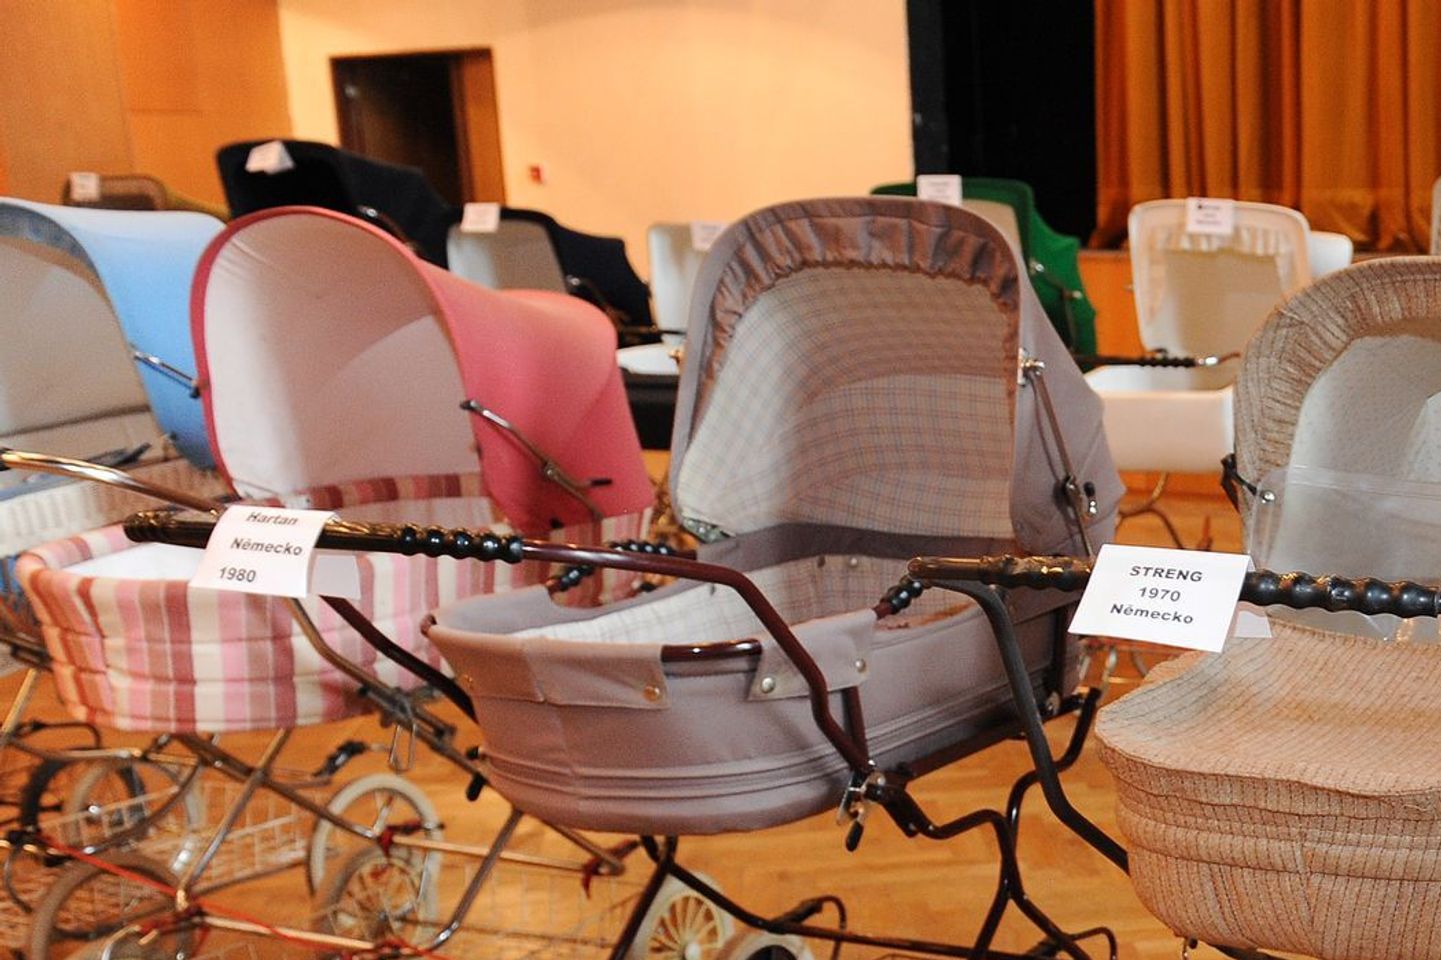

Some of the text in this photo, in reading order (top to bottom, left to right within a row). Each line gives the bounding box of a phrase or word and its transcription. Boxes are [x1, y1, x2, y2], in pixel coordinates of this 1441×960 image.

[246, 511, 299, 526] Hartan
[230, 537, 303, 556] Německo
[219, 566, 257, 583] 1980
[1130, 565, 1204, 582] STRENG
[1138, 586, 1182, 602] 1970
[1110, 603, 1194, 625] Německo
